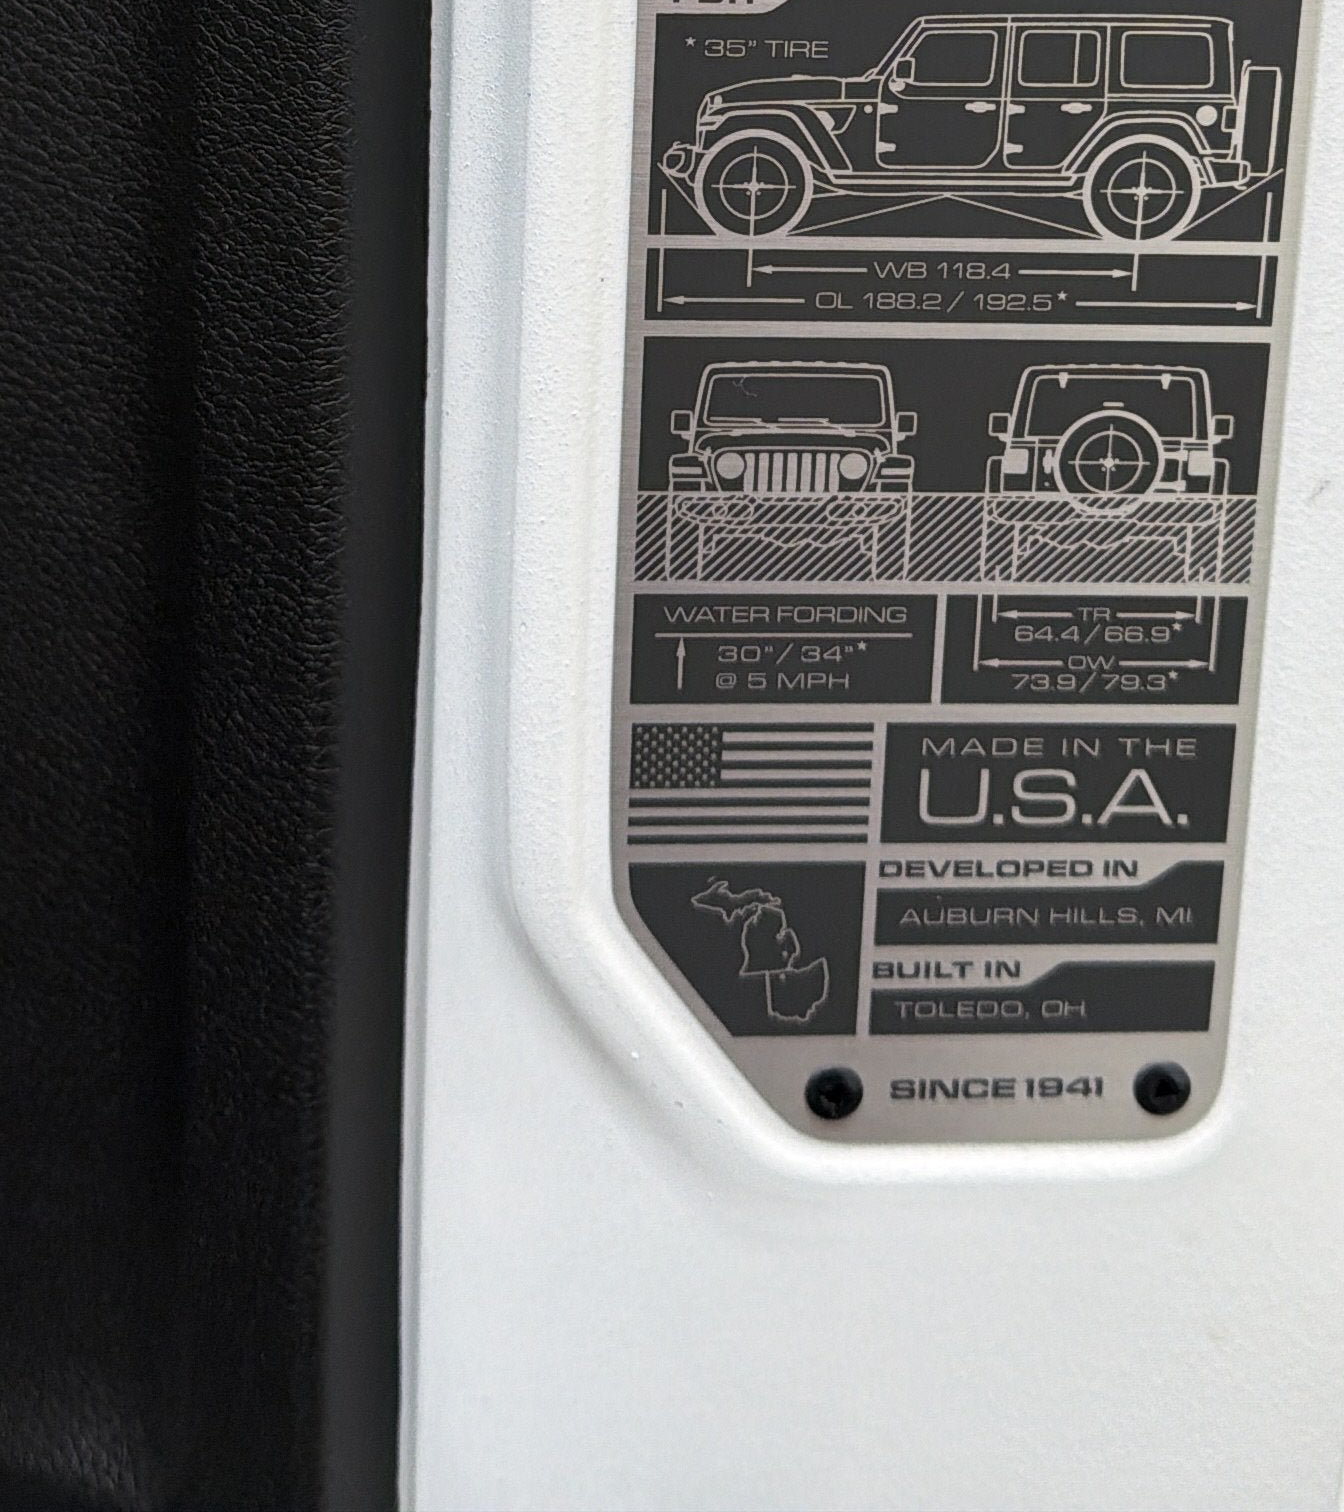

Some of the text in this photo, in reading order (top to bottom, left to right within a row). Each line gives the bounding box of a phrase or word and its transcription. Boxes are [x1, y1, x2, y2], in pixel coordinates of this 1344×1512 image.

[765, 39, 830, 59] TIRE
[873, 261, 1011, 281] WB 118.4
[815, 291, 855, 311] OL
[863, 291, 943, 312] 188.2
[664, 605, 908, 624] WATER FORDING
[1077, 607, 1113, 622] TR
[1067, 655, 1115, 670] OW
[715, 672, 850, 691] @ 5 MPH
[922, 738, 1197, 757] MADE IN THE
[918, 768, 1191, 827] U.S.A.
[879, 860, 1139, 879] DEVELOPED IN
[899, 906, 1194, 928] AUBURN HILLS, MI
[872, 962, 1022, 980] BUILT IN
[894, 998, 1087, 1021] TOLEDO, OH
[890, 1076, 1104, 1101] SINCE 1941
